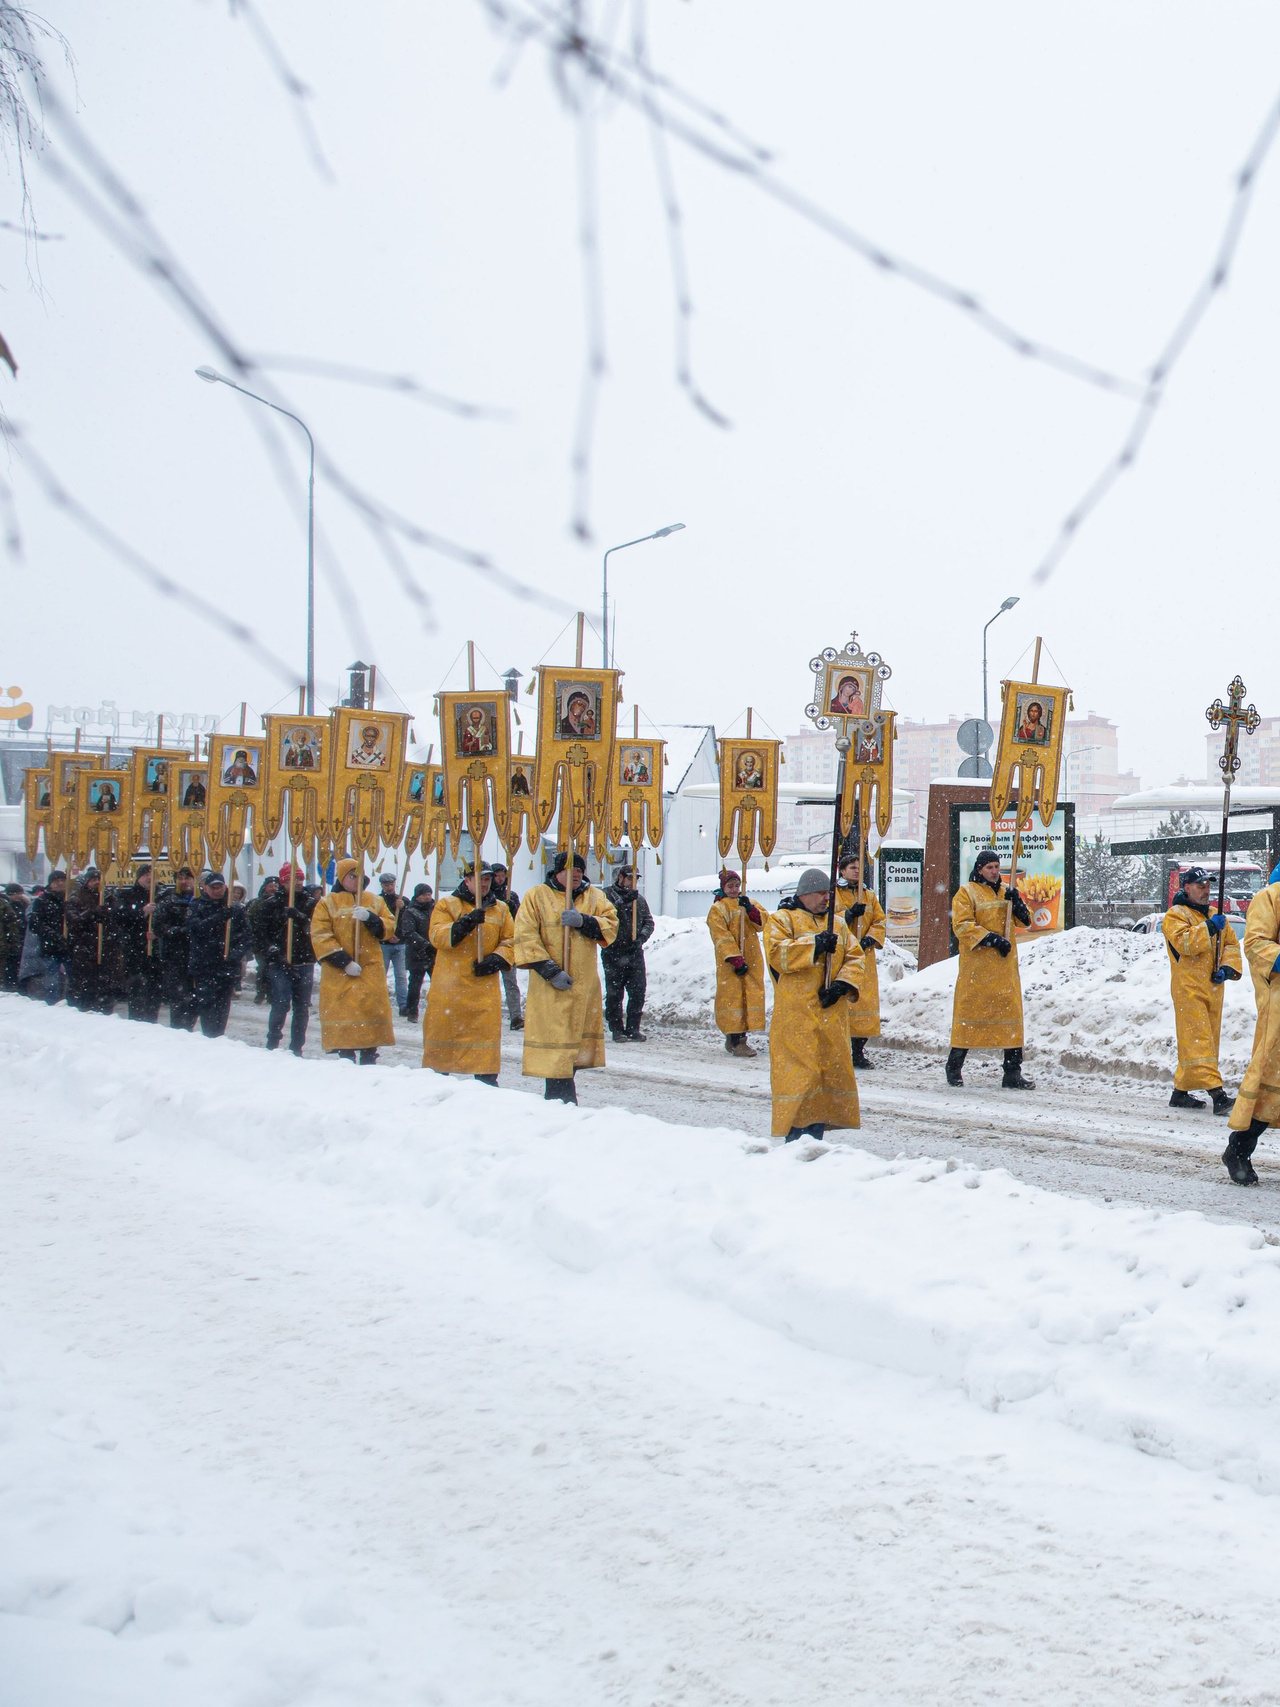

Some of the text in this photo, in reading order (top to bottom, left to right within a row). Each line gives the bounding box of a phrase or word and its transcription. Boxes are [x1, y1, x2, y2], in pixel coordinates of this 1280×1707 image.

[994, 821, 1030, 830] КОМО
[969, 834, 1010, 844] Двойым
[888, 865, 918, 874] Снова
